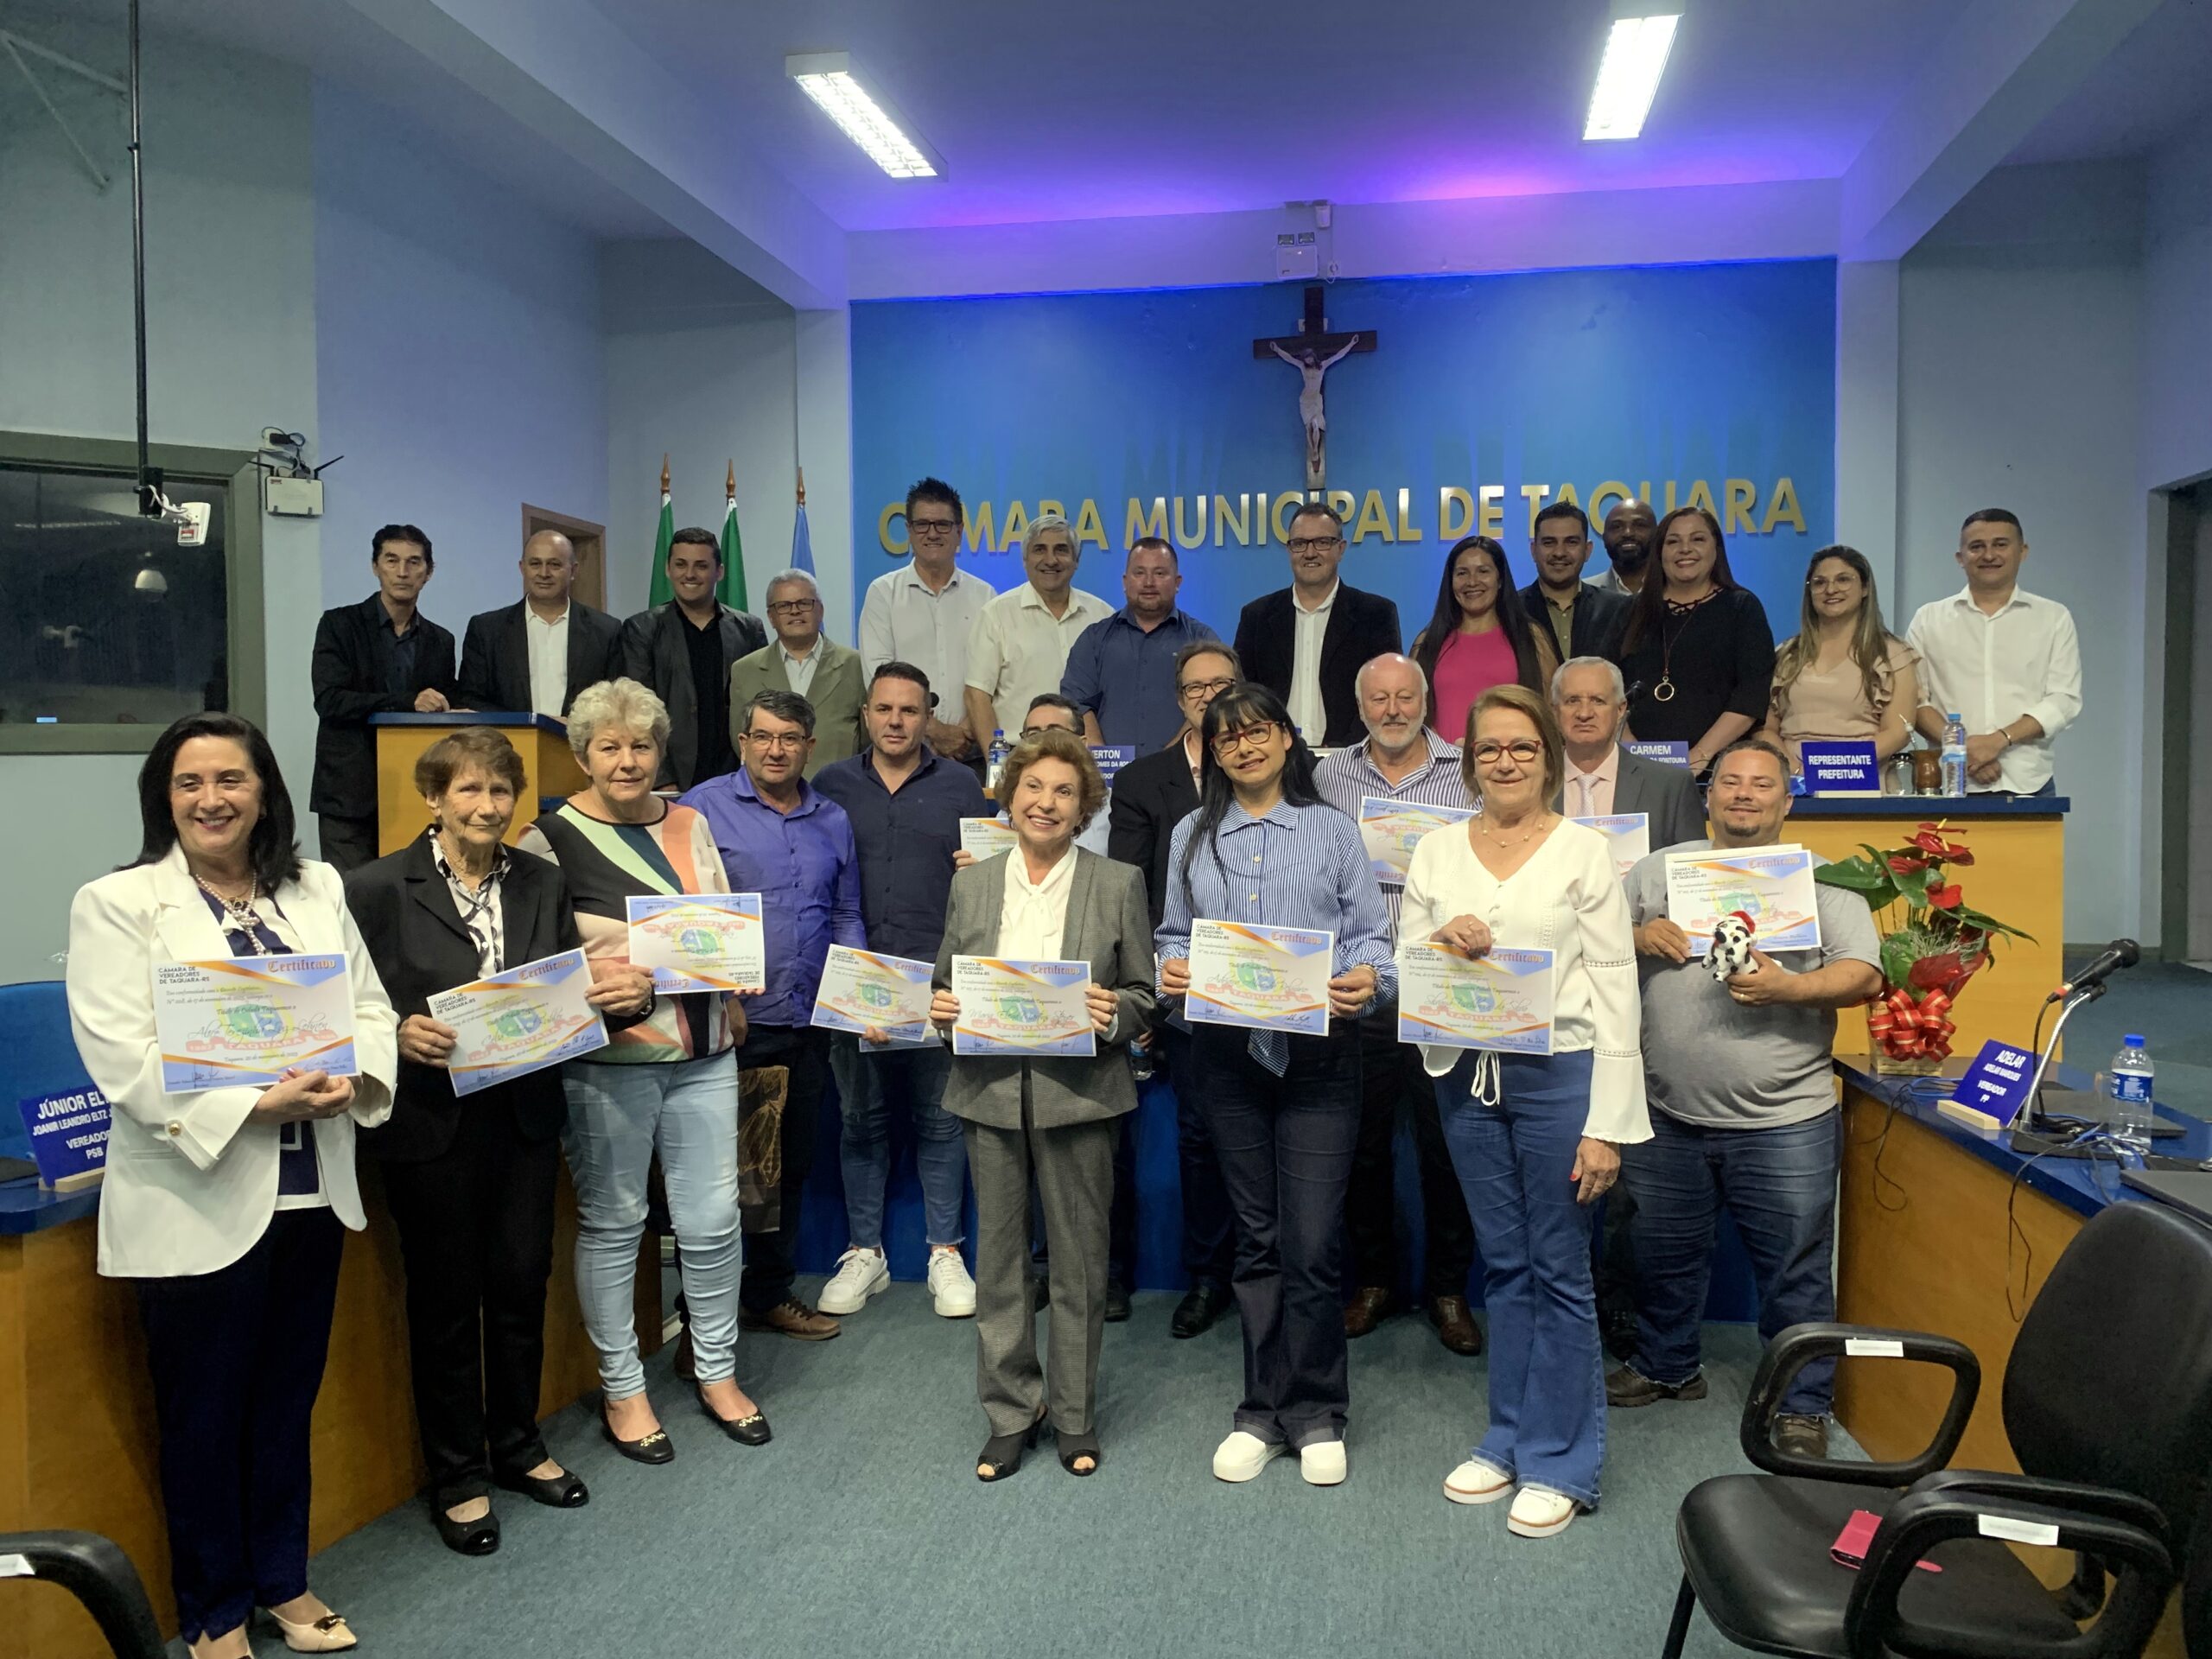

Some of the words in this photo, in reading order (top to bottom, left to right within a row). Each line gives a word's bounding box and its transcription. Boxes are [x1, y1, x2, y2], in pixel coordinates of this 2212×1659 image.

[879, 499, 1109, 554] CMAA
[1125, 487, 1422, 549] MUNICPAL
[1440, 486, 1503, 541] DE
[1092, 749, 1121, 760] ERTON
[1630, 745, 1671, 755] CARMEM
[1808, 754, 1872, 766] REPRESENTANTE
[1818, 769, 1865, 779] PREFEITURA
[268, 958, 336, 973] Certificado
[1994, 1049, 2026, 1069] ADELAR
[1977, 1079, 2006, 1096] VEREADOR
[37, 1094, 87, 1120] JÚNIOR
[33, 1122, 60, 1136] JOANIR
[59, 1114, 92, 1129] LEANDRO
[91, 1109, 108, 1122] ELTZ
[66, 1130, 111, 1149] VEREADOR
[86, 1147, 104, 1160] PSB
